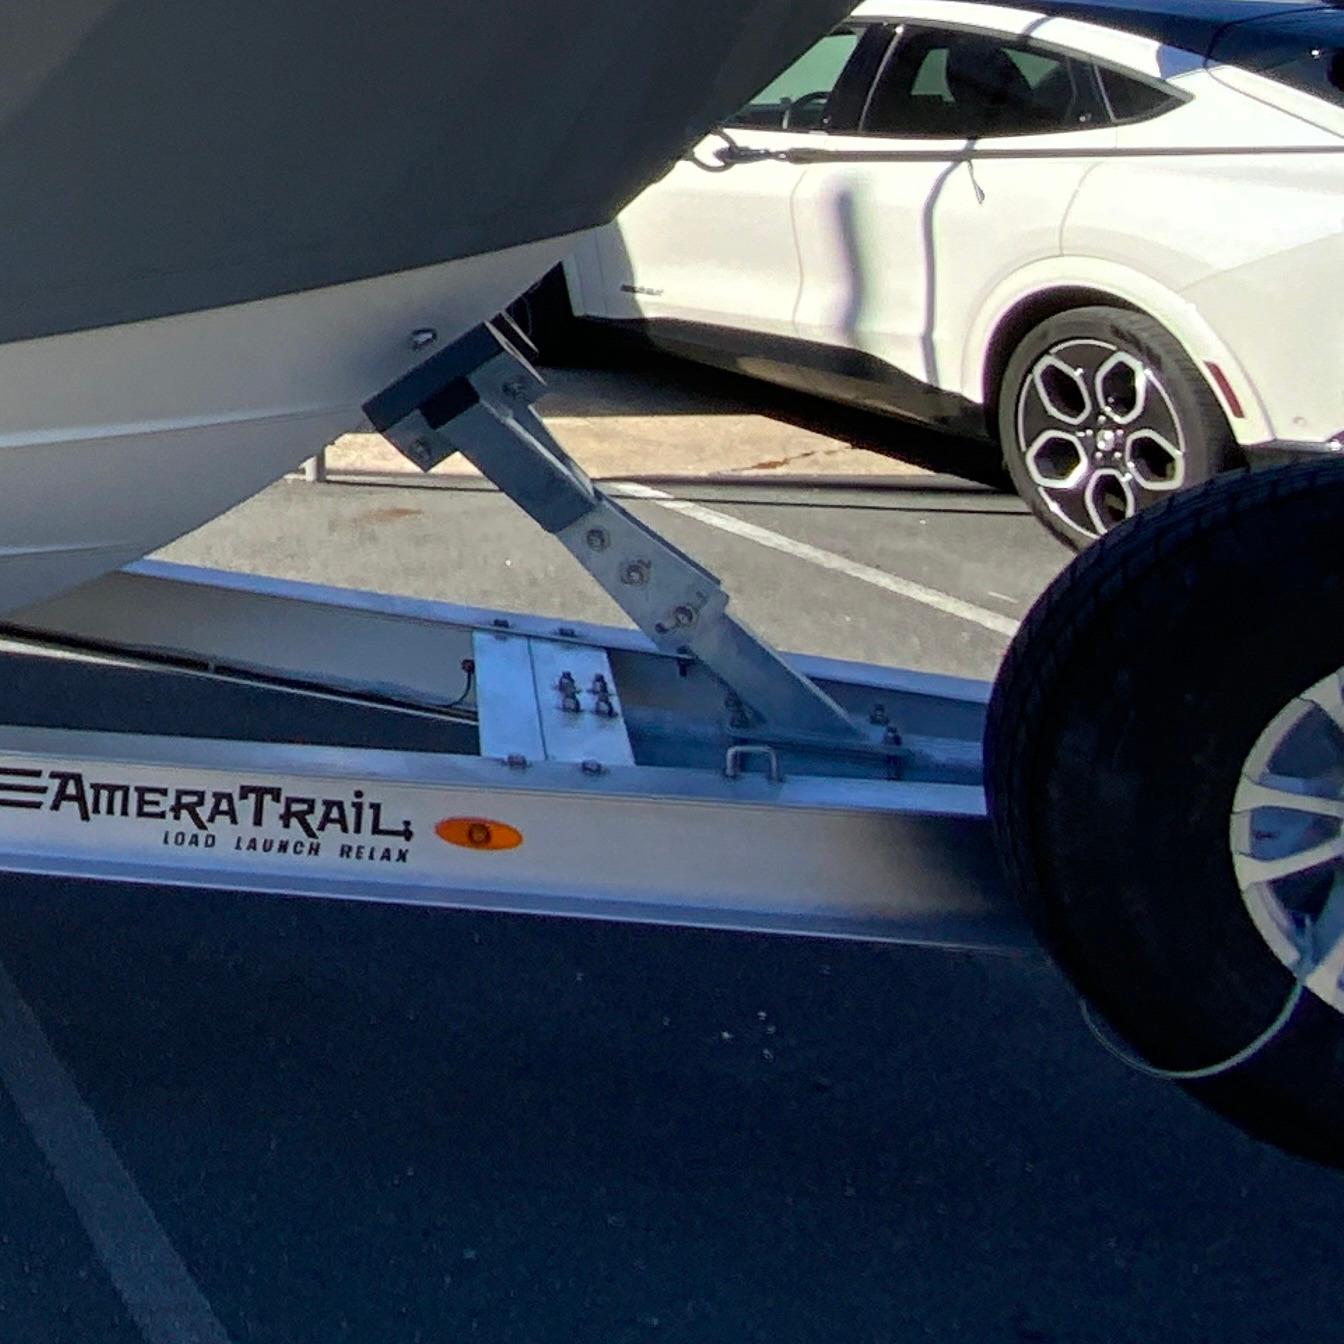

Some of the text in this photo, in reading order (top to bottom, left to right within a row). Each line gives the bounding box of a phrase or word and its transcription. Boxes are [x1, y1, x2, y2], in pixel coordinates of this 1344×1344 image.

[163, 830, 410, 864] LOAD LAUNCH RELAX
